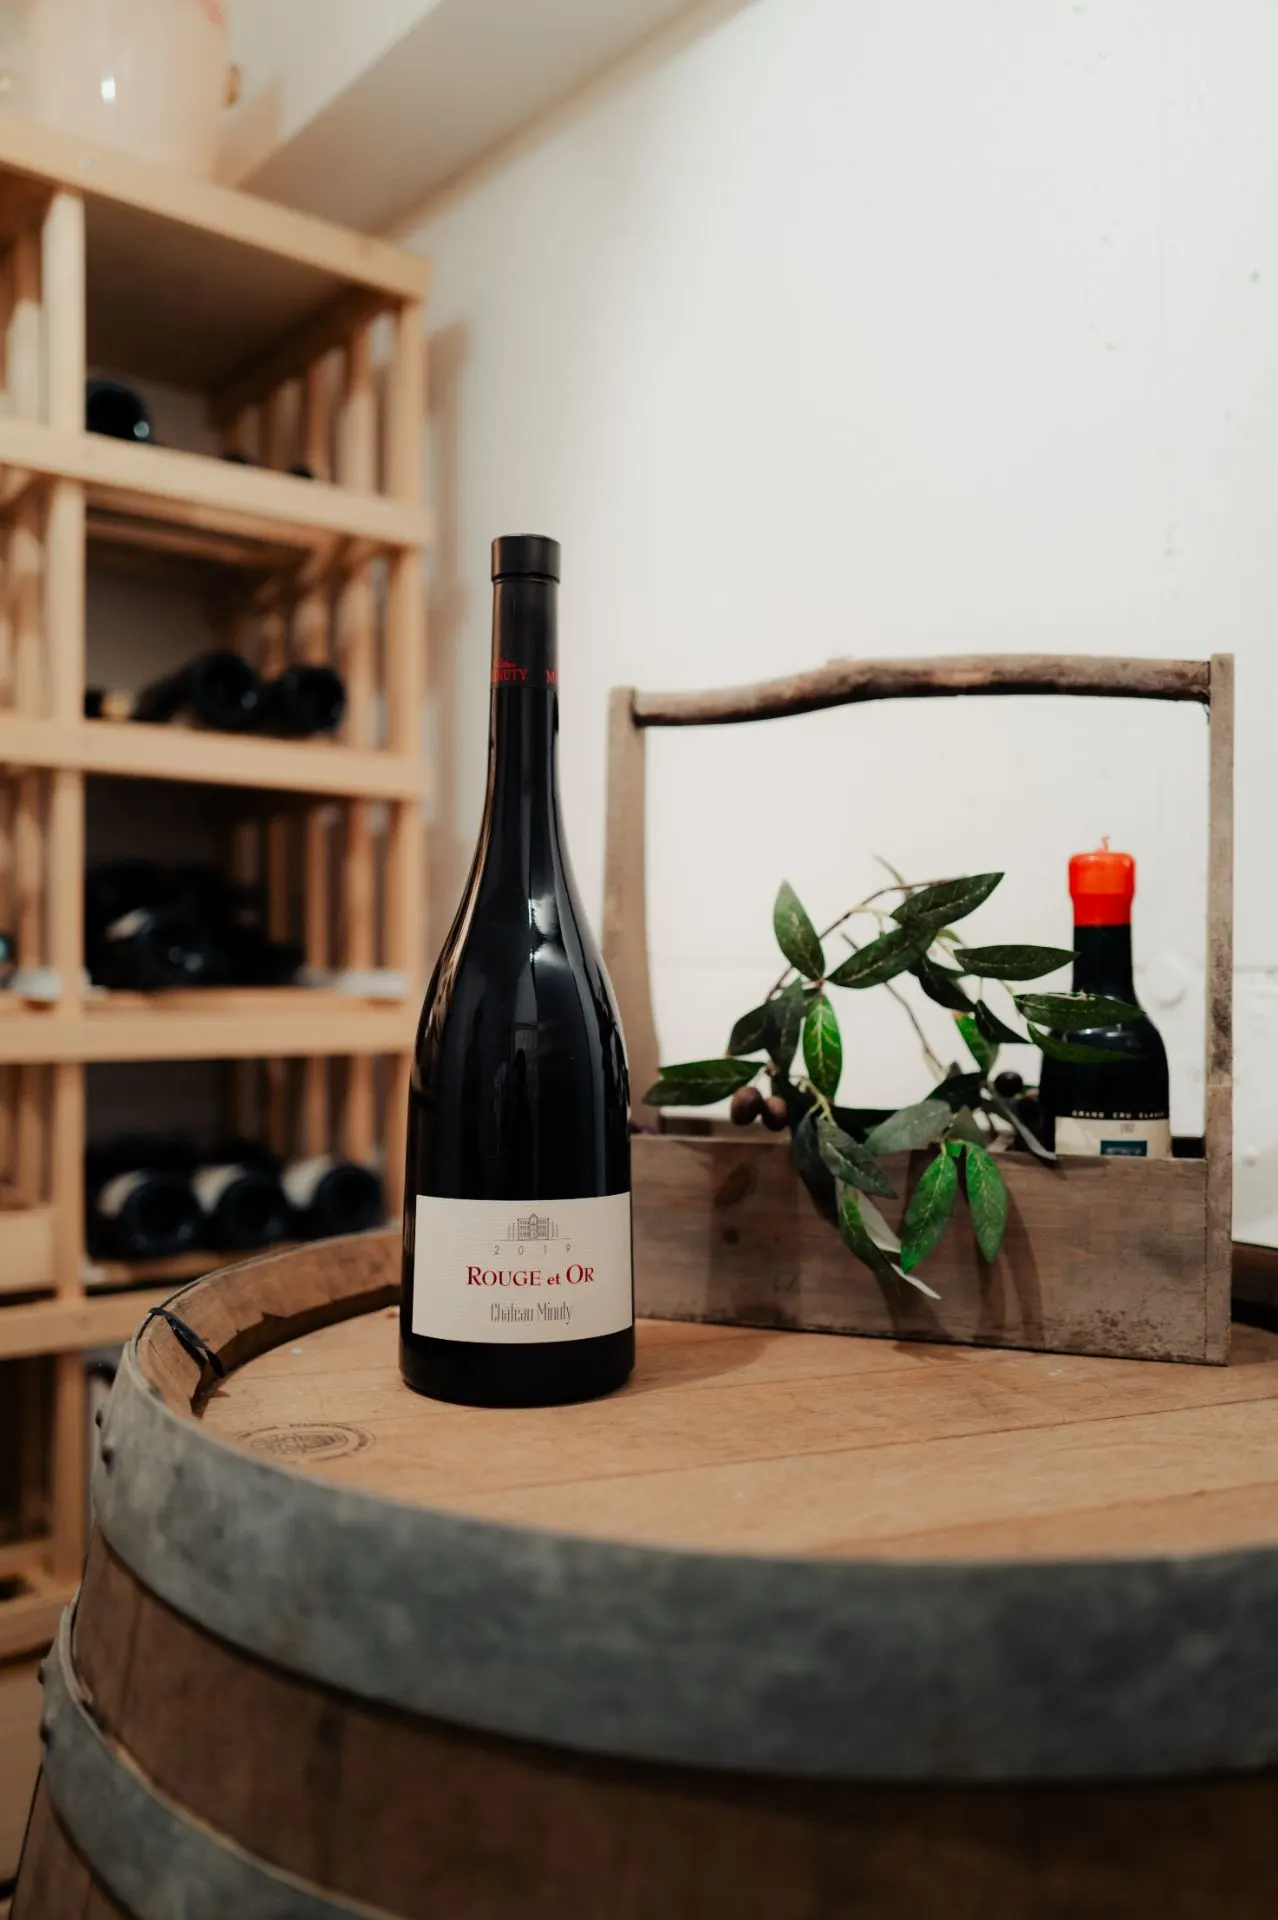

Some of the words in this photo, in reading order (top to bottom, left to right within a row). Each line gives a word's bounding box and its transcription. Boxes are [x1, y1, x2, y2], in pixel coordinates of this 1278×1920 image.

[1072, 1110, 1104, 1118] GRAND
[1112, 1111, 1132, 1119] CRU
[494, 1244, 571, 1255] 2019
[466, 1265, 541, 1287] ROUGE
[546, 1273, 561, 1286] et
[566, 1263, 595, 1284] OR
[536, 1300, 572, 1325] Minuty
